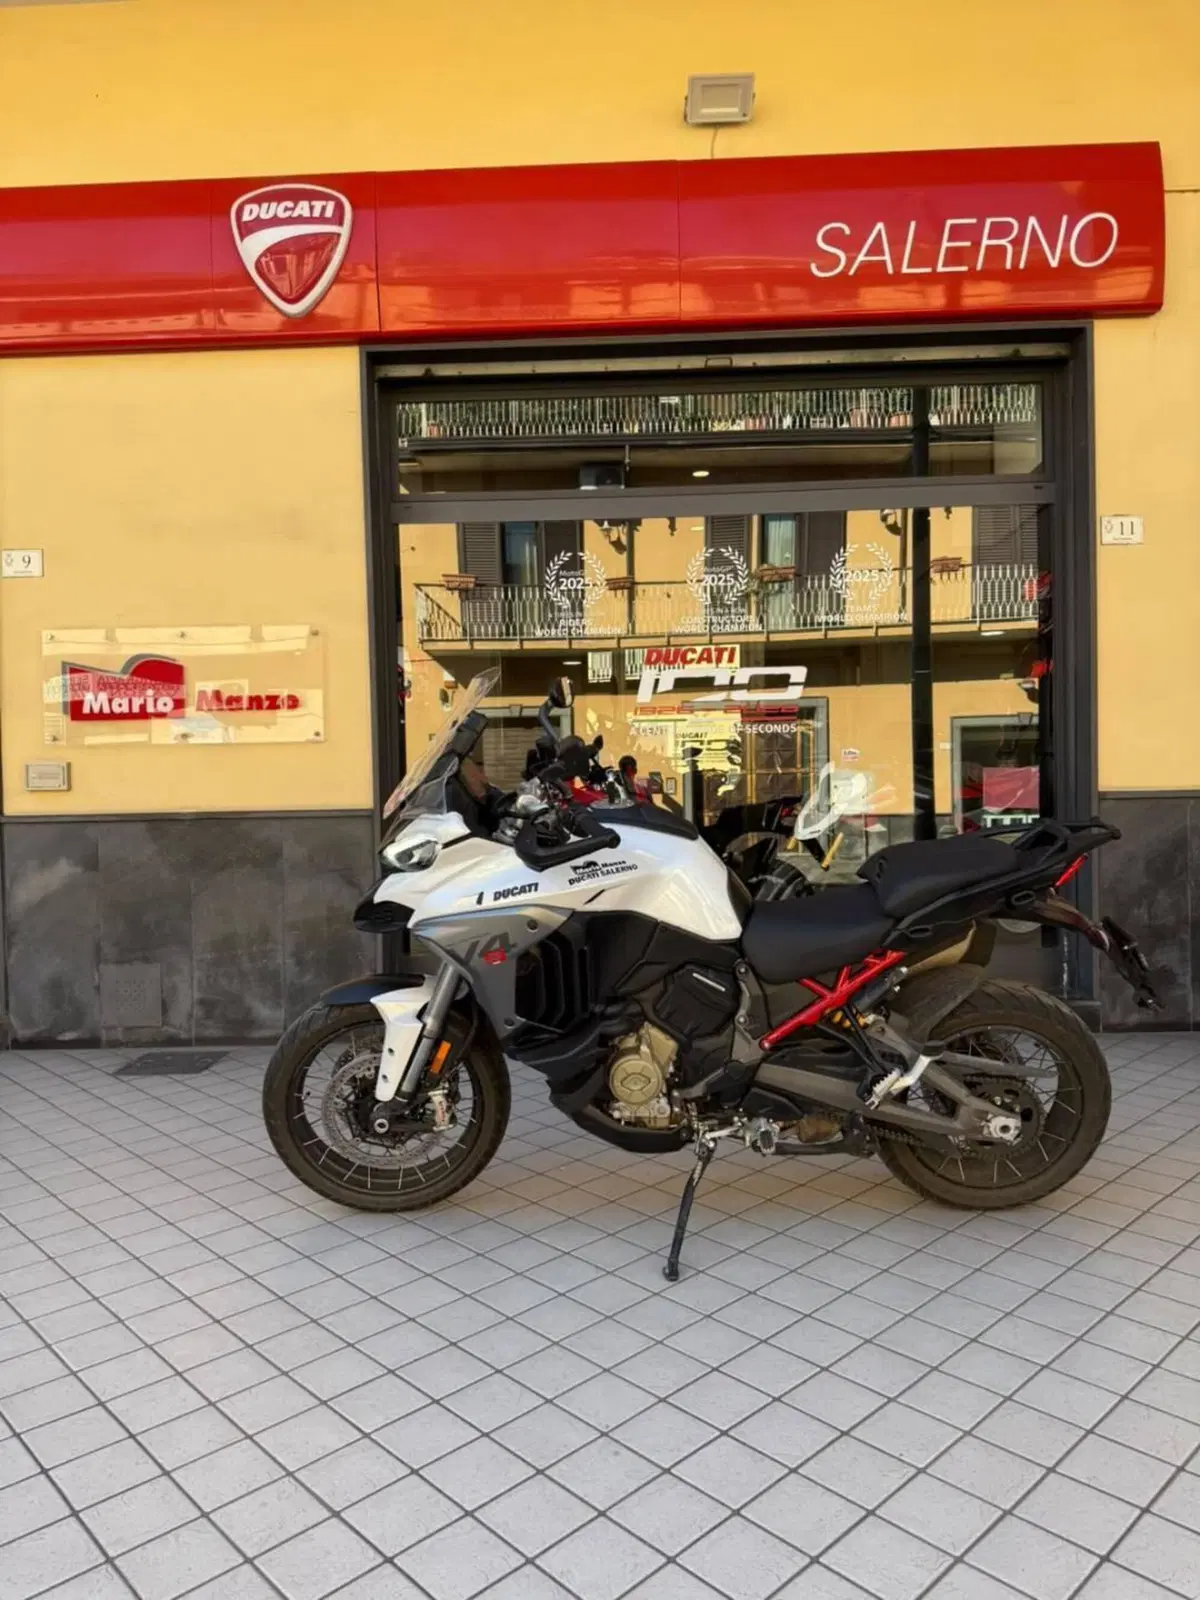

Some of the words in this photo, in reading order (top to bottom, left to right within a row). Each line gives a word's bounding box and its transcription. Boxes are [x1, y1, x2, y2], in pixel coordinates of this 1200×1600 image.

[241, 200, 337, 223] DUCATI
[809, 211, 1120, 279] SALERNO
[1120, 520, 1134, 536] 11
[22, 554, 31, 569] 9
[703, 574, 735, 586] 2025
[844, 569, 880, 582] 2025
[559, 577, 593, 591] 2025
[681, 614, 755, 625] CONSTRUCTORS
[535, 627, 569, 637] WORLD
[673, 625, 709, 634] WORLD
[711, 623, 762, 633] CHAMPION
[645, 647, 737, 666] DUCATI
[82, 688, 174, 715] Mario
[196, 689, 300, 712] Manzo
[745, 722, 798, 734] SECONDS
[568, 871, 599, 886] DUCATI
[600, 864, 639, 877] SALERNO
[493, 882, 539, 902] DUCATI
